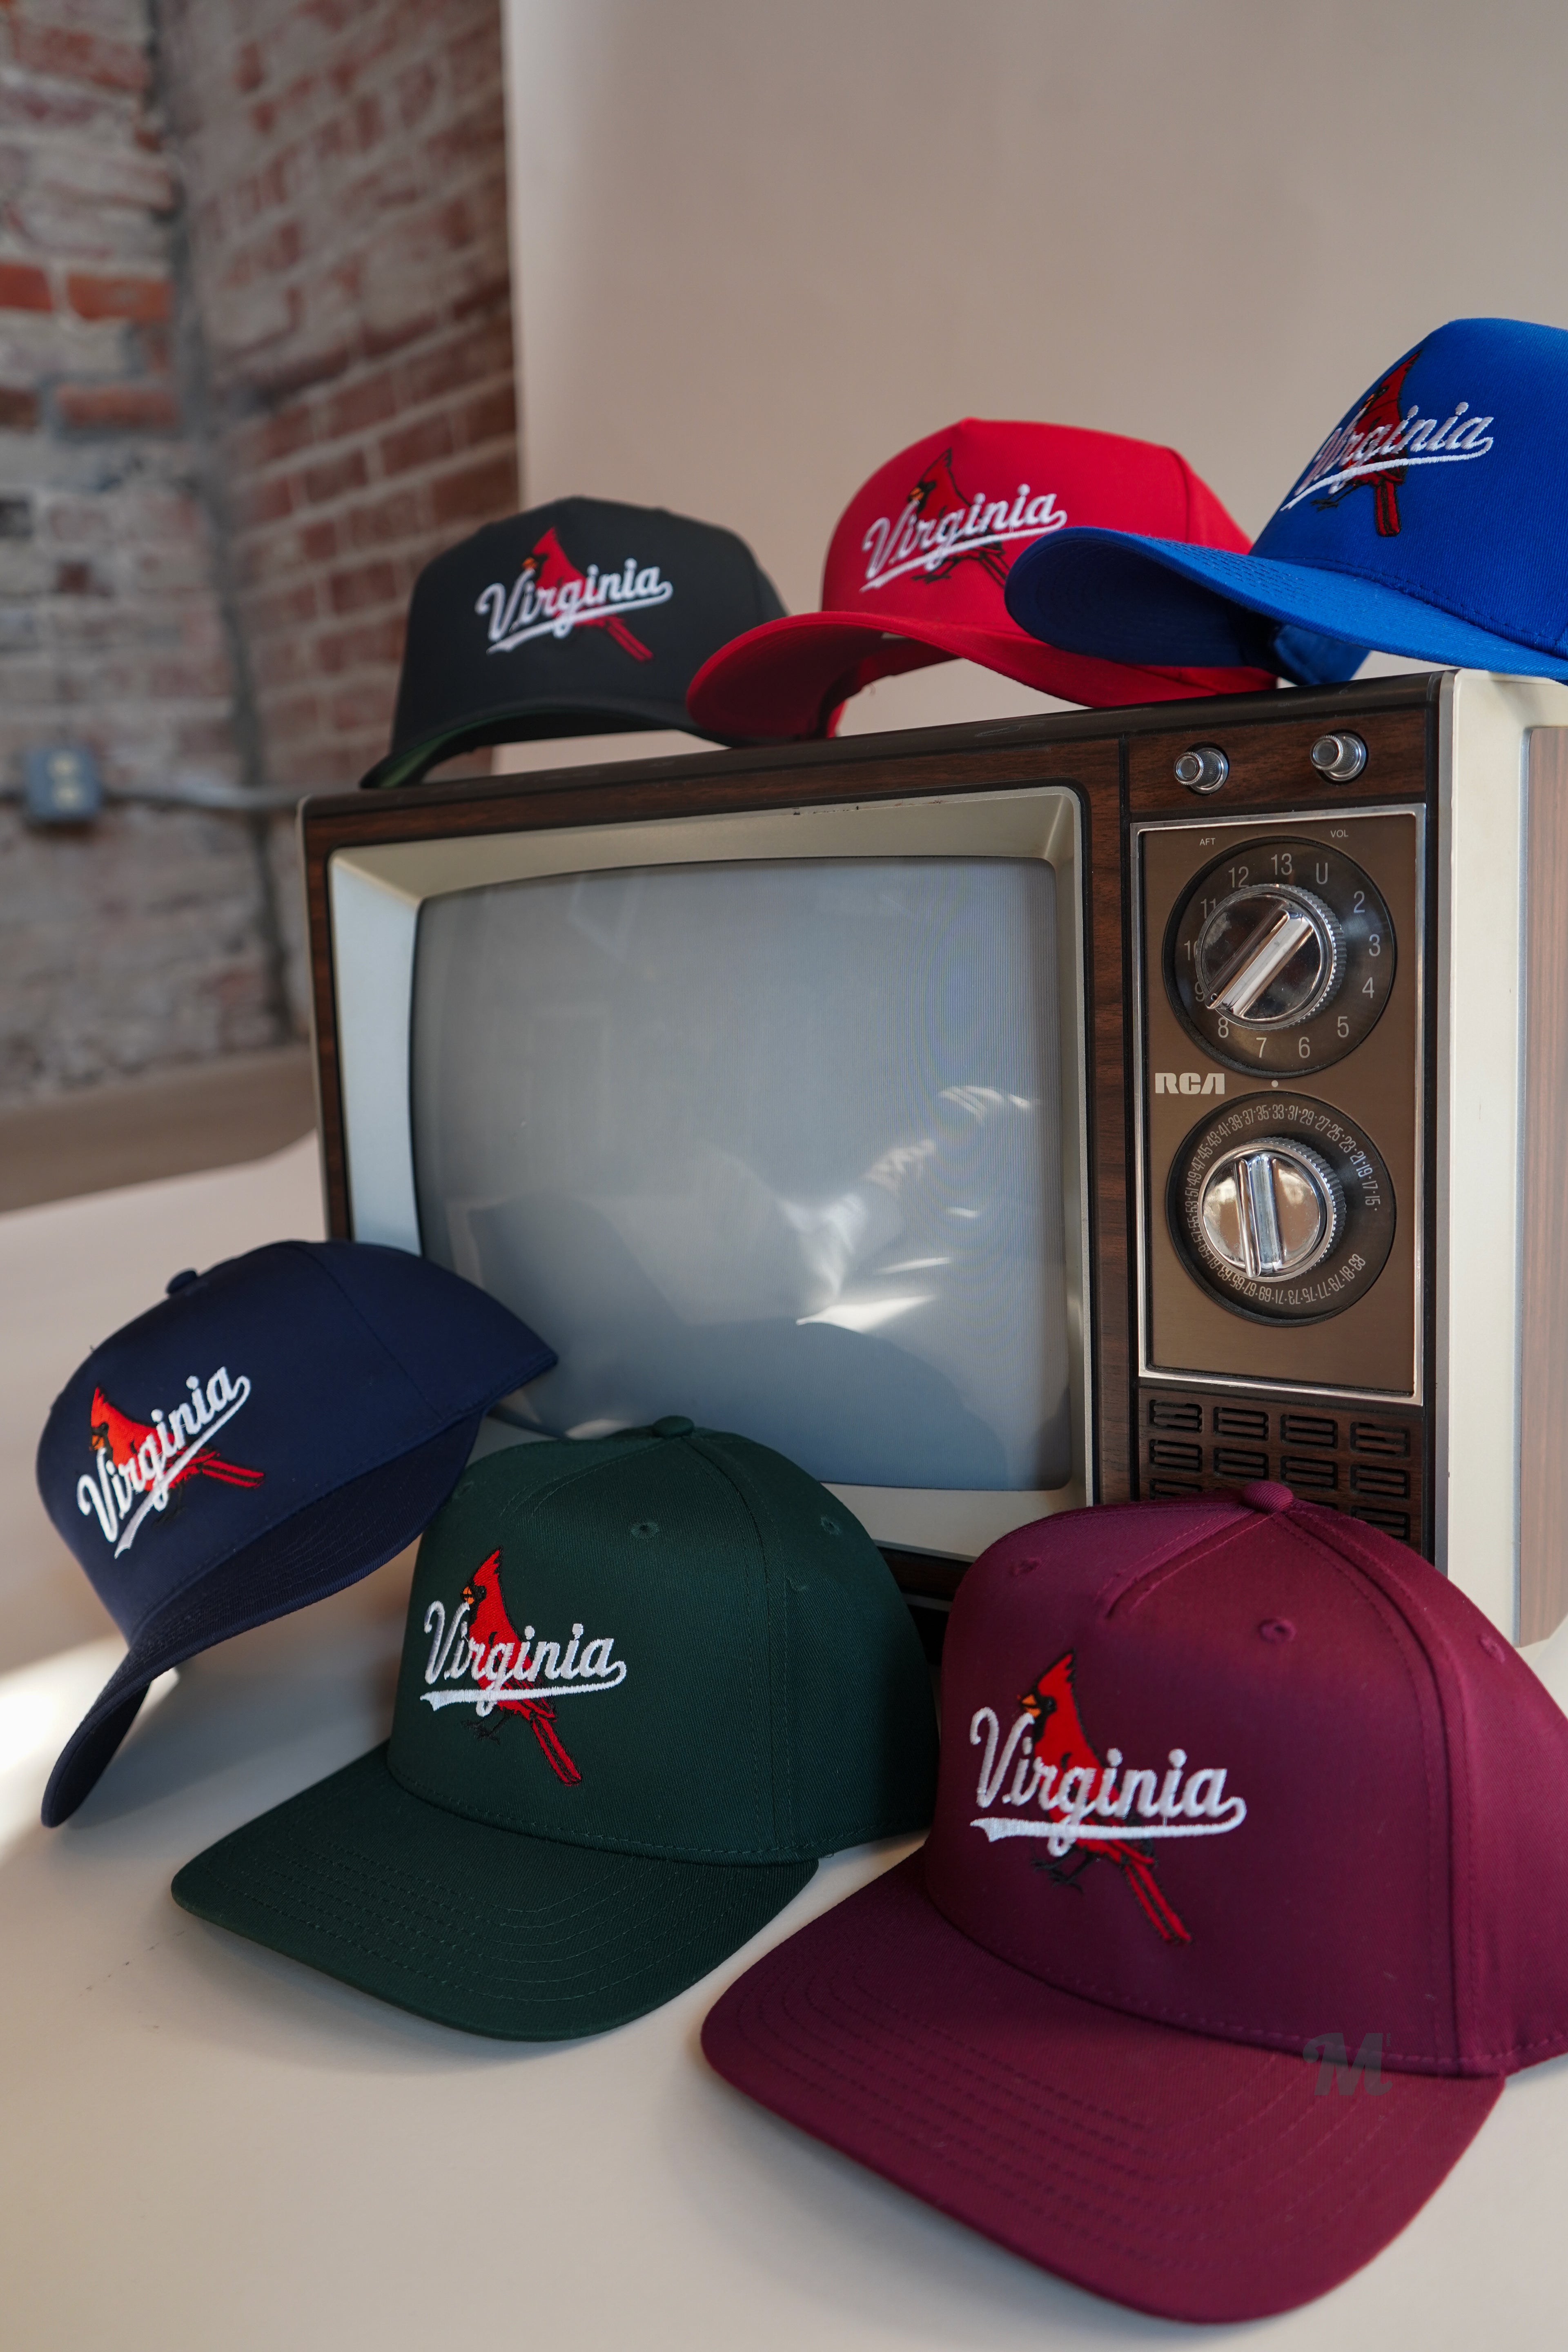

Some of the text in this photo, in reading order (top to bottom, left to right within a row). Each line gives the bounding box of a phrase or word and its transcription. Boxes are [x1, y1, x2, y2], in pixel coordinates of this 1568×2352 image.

[1280, 401, 1494, 511] Virginia
[859, 483, 1067, 592] Virginia
[474, 557, 673, 654] Virginia
[1199, 837, 1216, 846] AFT
[1330, 830, 1349, 838] VOL
[1271, 853, 1292, 875] 13
[1228, 866, 1250, 888] 12
[1316, 862, 1328, 884] U
[1353, 891, 1365, 913] 2
[1369, 934, 1381, 956] 3
[1195, 981, 1205, 1002] 9
[1362, 977, 1374, 998] 4
[1218, 1018, 1229, 1038] 8
[1337, 1016, 1349, 1038] 5
[1256, 1038, 1267, 1058] 7
[1298, 1037, 1310, 1058] 6
[1155, 1073, 1225, 1094] RCA
[1243, 1108, 1254, 1125] 37
[1256, 1105, 1269, 1120] 35
[1272, 1104, 1284, 1119] 33
[1288, 1105, 1298, 1120] 31
[1299, 1109, 1314, 1125] 29
[1218, 1122, 1231, 1137] 41
[1228, 1114, 1243, 1131] 39
[1315, 1116, 1330, 1131] 27
[1207, 1131, 1222, 1147] 43
[1327, 1124, 1343, 1141] 25
[1197, 1143, 1213, 1158] 45
[1339, 1136, 1356, 1153] 23
[1191, 1157, 1205, 1169] 47
[1350, 1151, 1366, 1165] 21
[1187, 1171, 1202, 1185] 49
[1356, 1164, 1373, 1178] 19
[1185, 1188, 1199, 1197] 51
[1362, 1180, 1379, 1189] 17
[1365, 1196, 1381, 1205] 15
[1348, 1254, 1366, 1271] 83
[1230, 1274, 1245, 1290] 65
[1339, 1265, 1355, 1282] 81
[1243, 1281, 1257, 1297] 67
[1317, 1282, 1331, 1299] 77
[1328, 1274, 1345, 1292] 79
[1258, 1286, 1272, 1302] 69
[1276, 1290, 1284, 1304] 71
[1288, 1290, 1301, 1305] 73
[1302, 1287, 1316, 1303] 75
[77, 1366, 251, 1559] Virginia
[420, 1601, 626, 1717] Virginia
[970, 1707, 1247, 1857] Virginia
